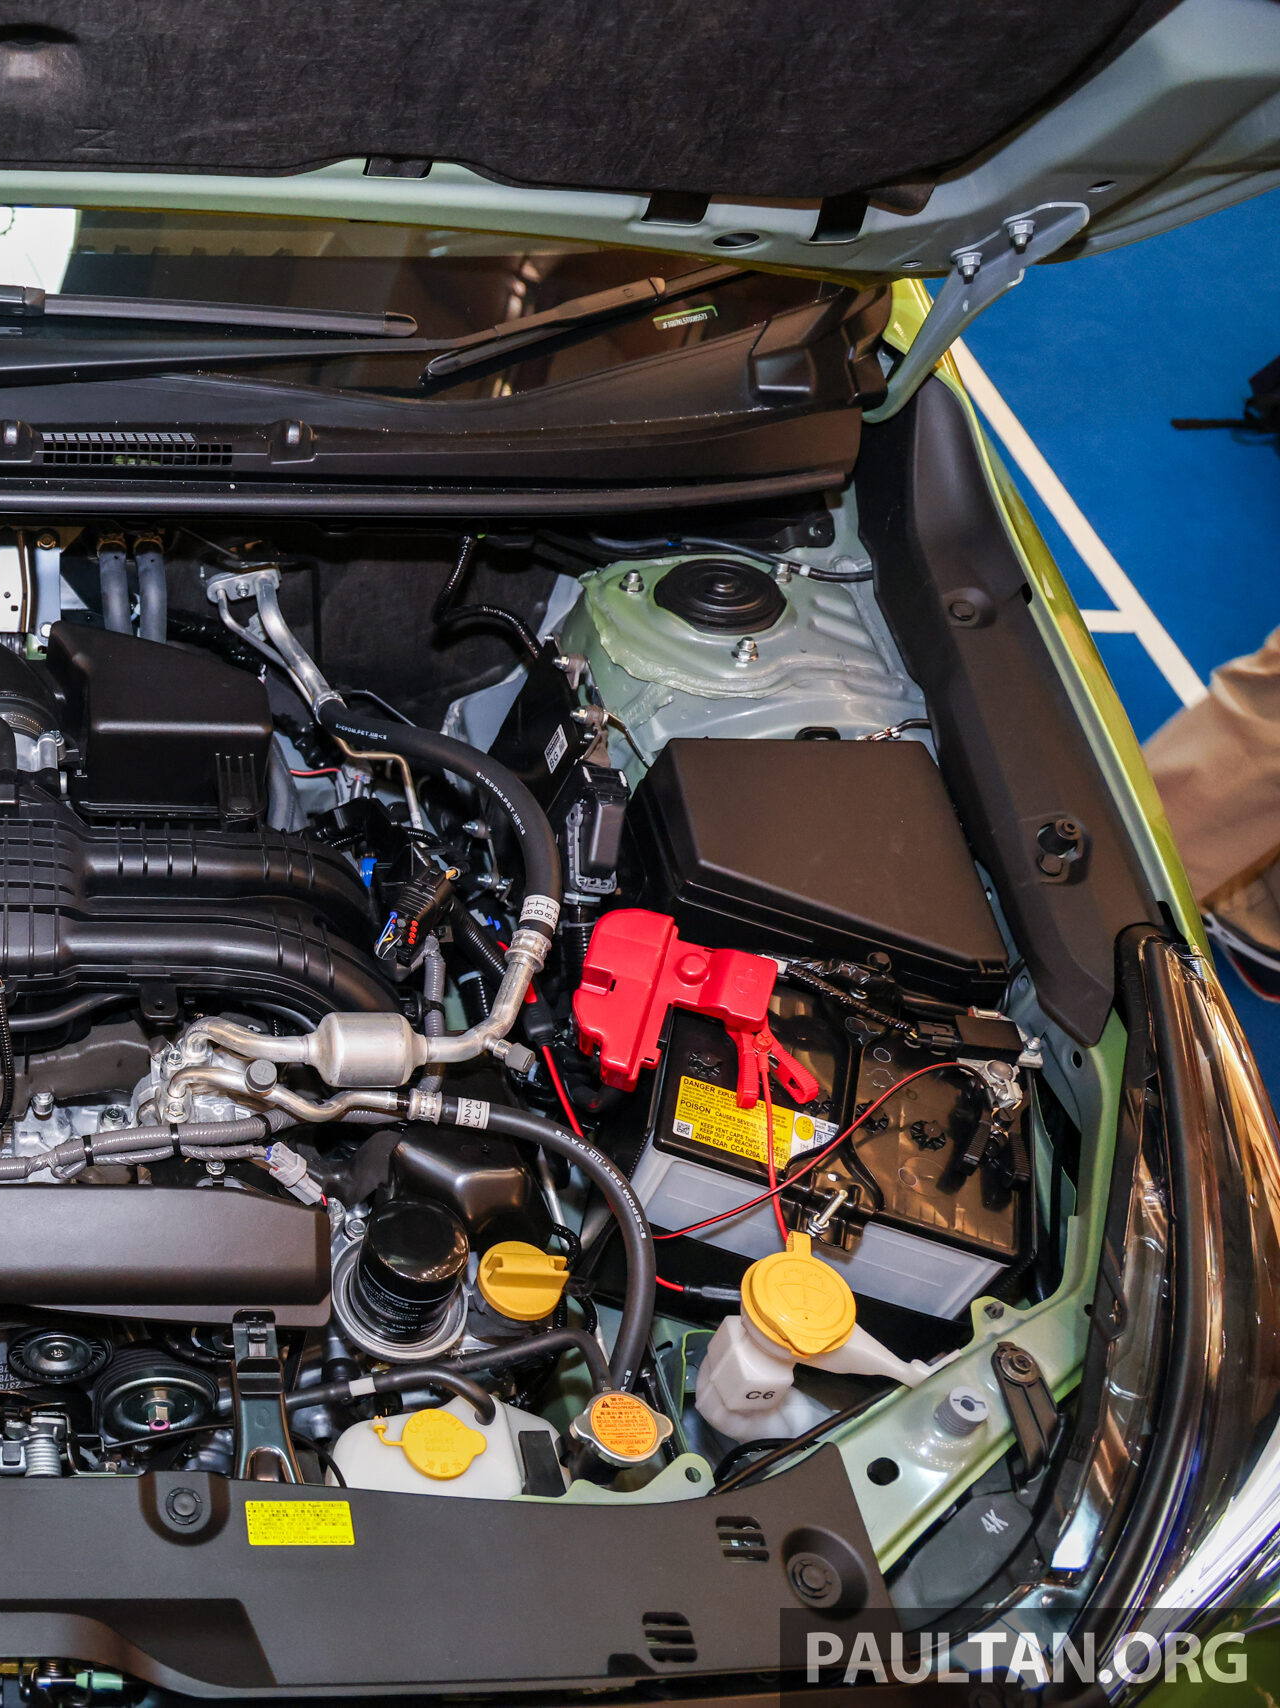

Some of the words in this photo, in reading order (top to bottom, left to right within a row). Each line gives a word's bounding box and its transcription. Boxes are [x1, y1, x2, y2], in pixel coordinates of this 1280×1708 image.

[683, 1078, 716, 1094] DANGER
[680, 1100, 711, 1114] POISON
[715, 1112, 736, 1122] CAUSES
[699, 1127, 714, 1137] KEEP
[714, 1132, 725, 1140] OUT
[734, 1137, 752, 1149] REACH
[700, 1122, 715, 1131] KEEP
[729, 1130, 744, 1140] CAPS
[695, 1133, 712, 1144] 20HR
[712, 1138, 728, 1149] 62Ah
[730, 1142, 744, 1154] CCA
[745, 1147, 761, 1159] 620A
[745, 1390, 776, 1400] C6
[980, 1508, 1009, 1535] 4K
